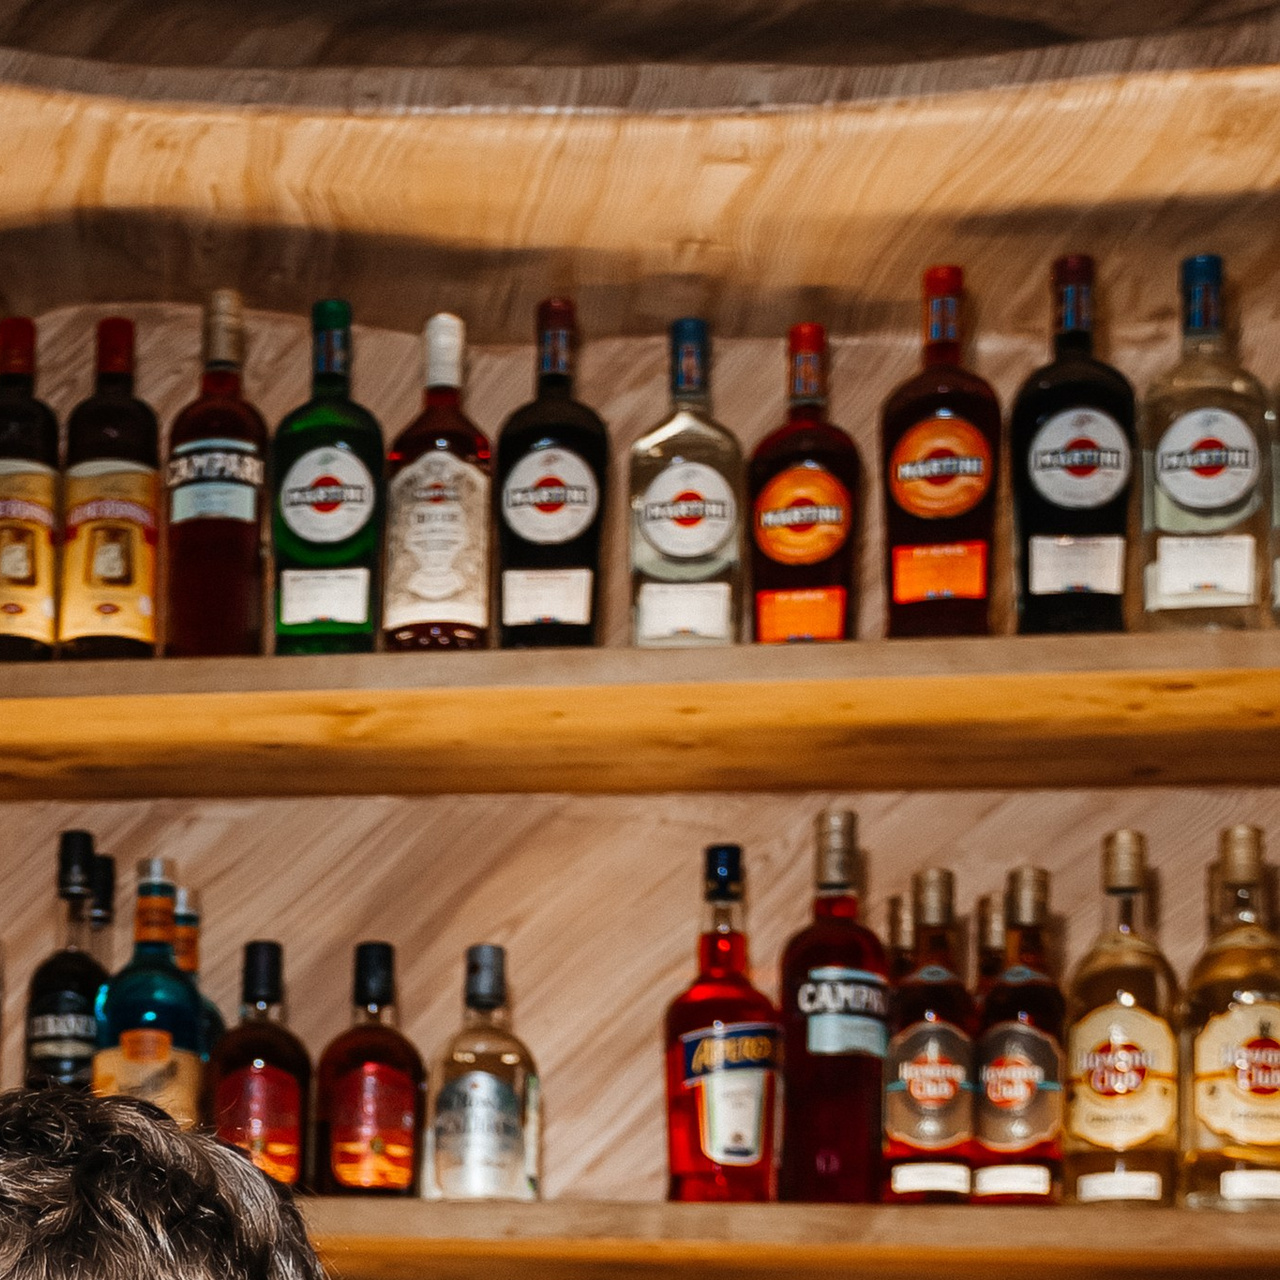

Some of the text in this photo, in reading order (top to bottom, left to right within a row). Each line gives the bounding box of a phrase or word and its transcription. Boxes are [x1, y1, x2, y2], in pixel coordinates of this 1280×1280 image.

[898, 457, 983, 481] MARTINI
[1036, 449, 1120, 470] MARTINI
[1162, 449, 1249, 471] MARTINI
